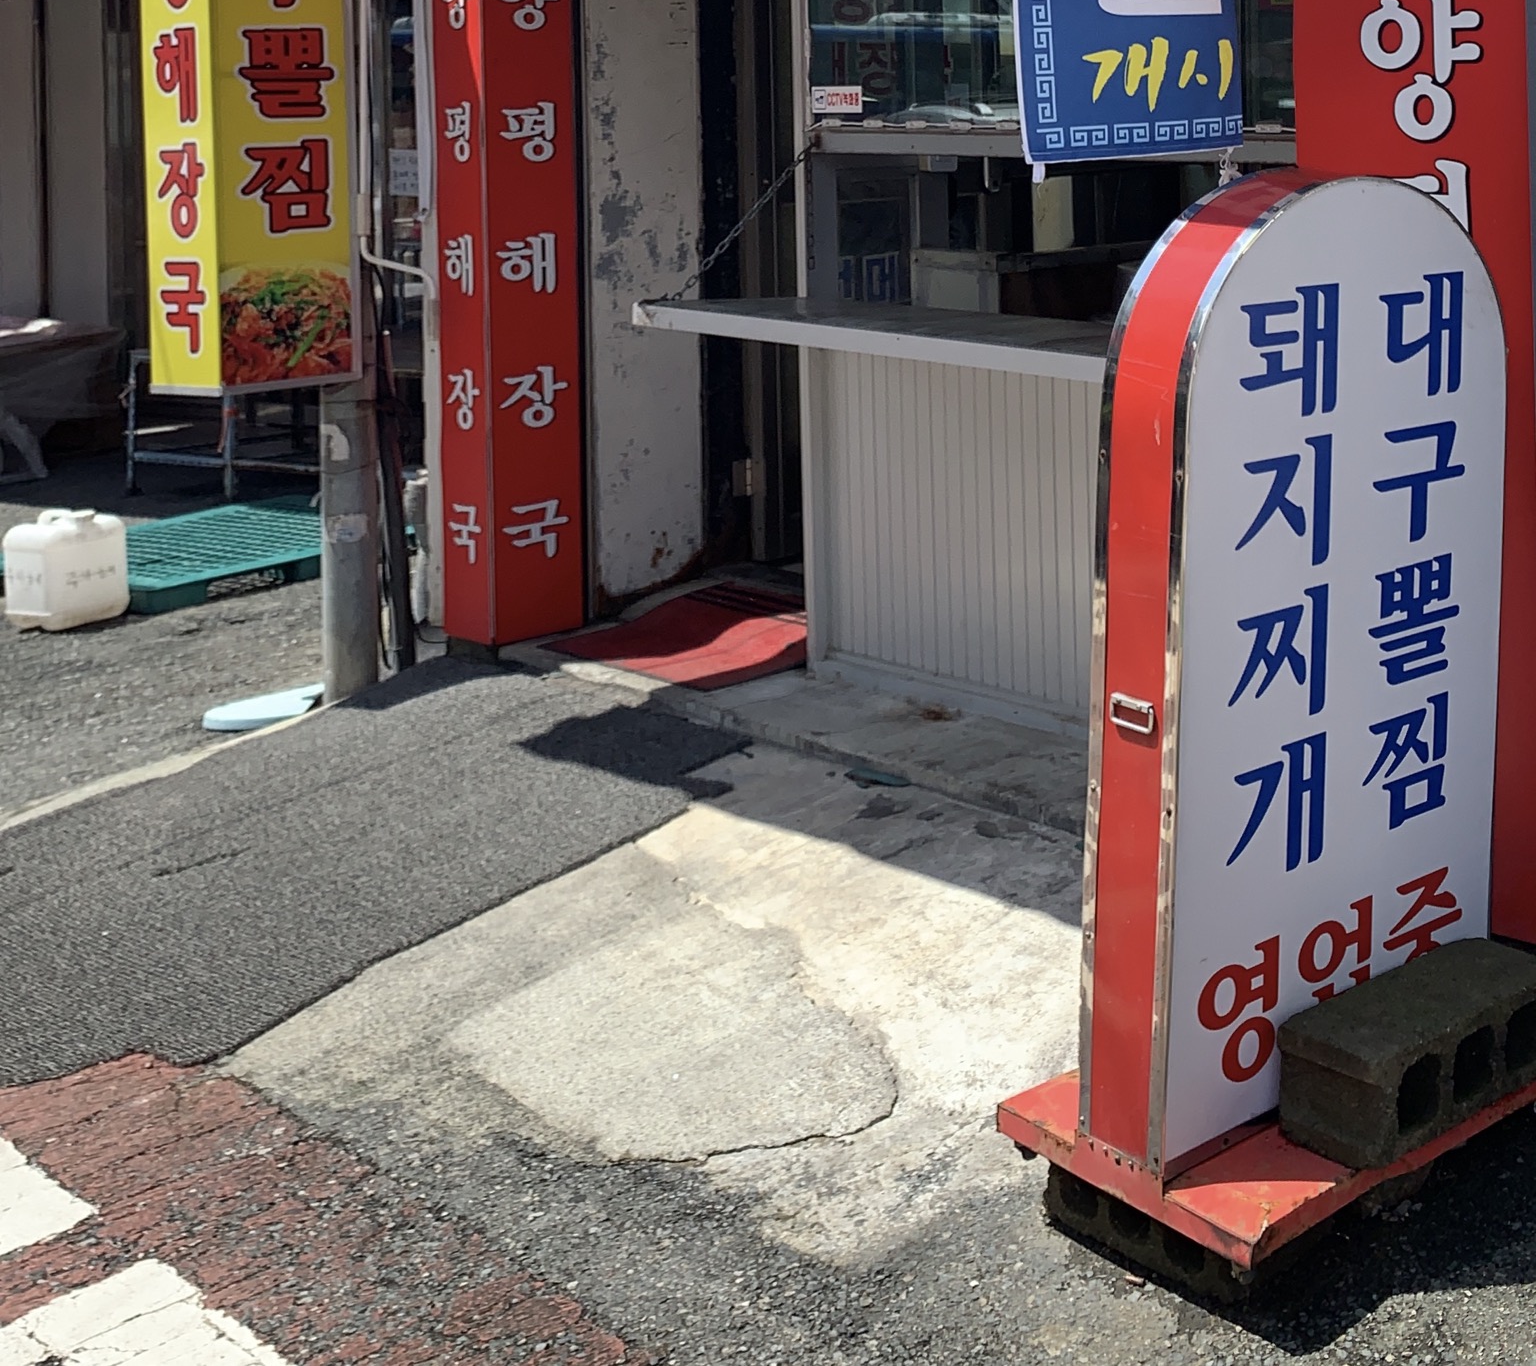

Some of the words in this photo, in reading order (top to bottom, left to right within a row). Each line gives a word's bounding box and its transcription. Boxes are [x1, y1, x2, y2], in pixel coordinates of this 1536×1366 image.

[1082, 36, 1235, 113] 개시
[1224, 282, 1341, 873] 돼지찌개
[1362, 271, 1466, 831] 대구뽈찜
